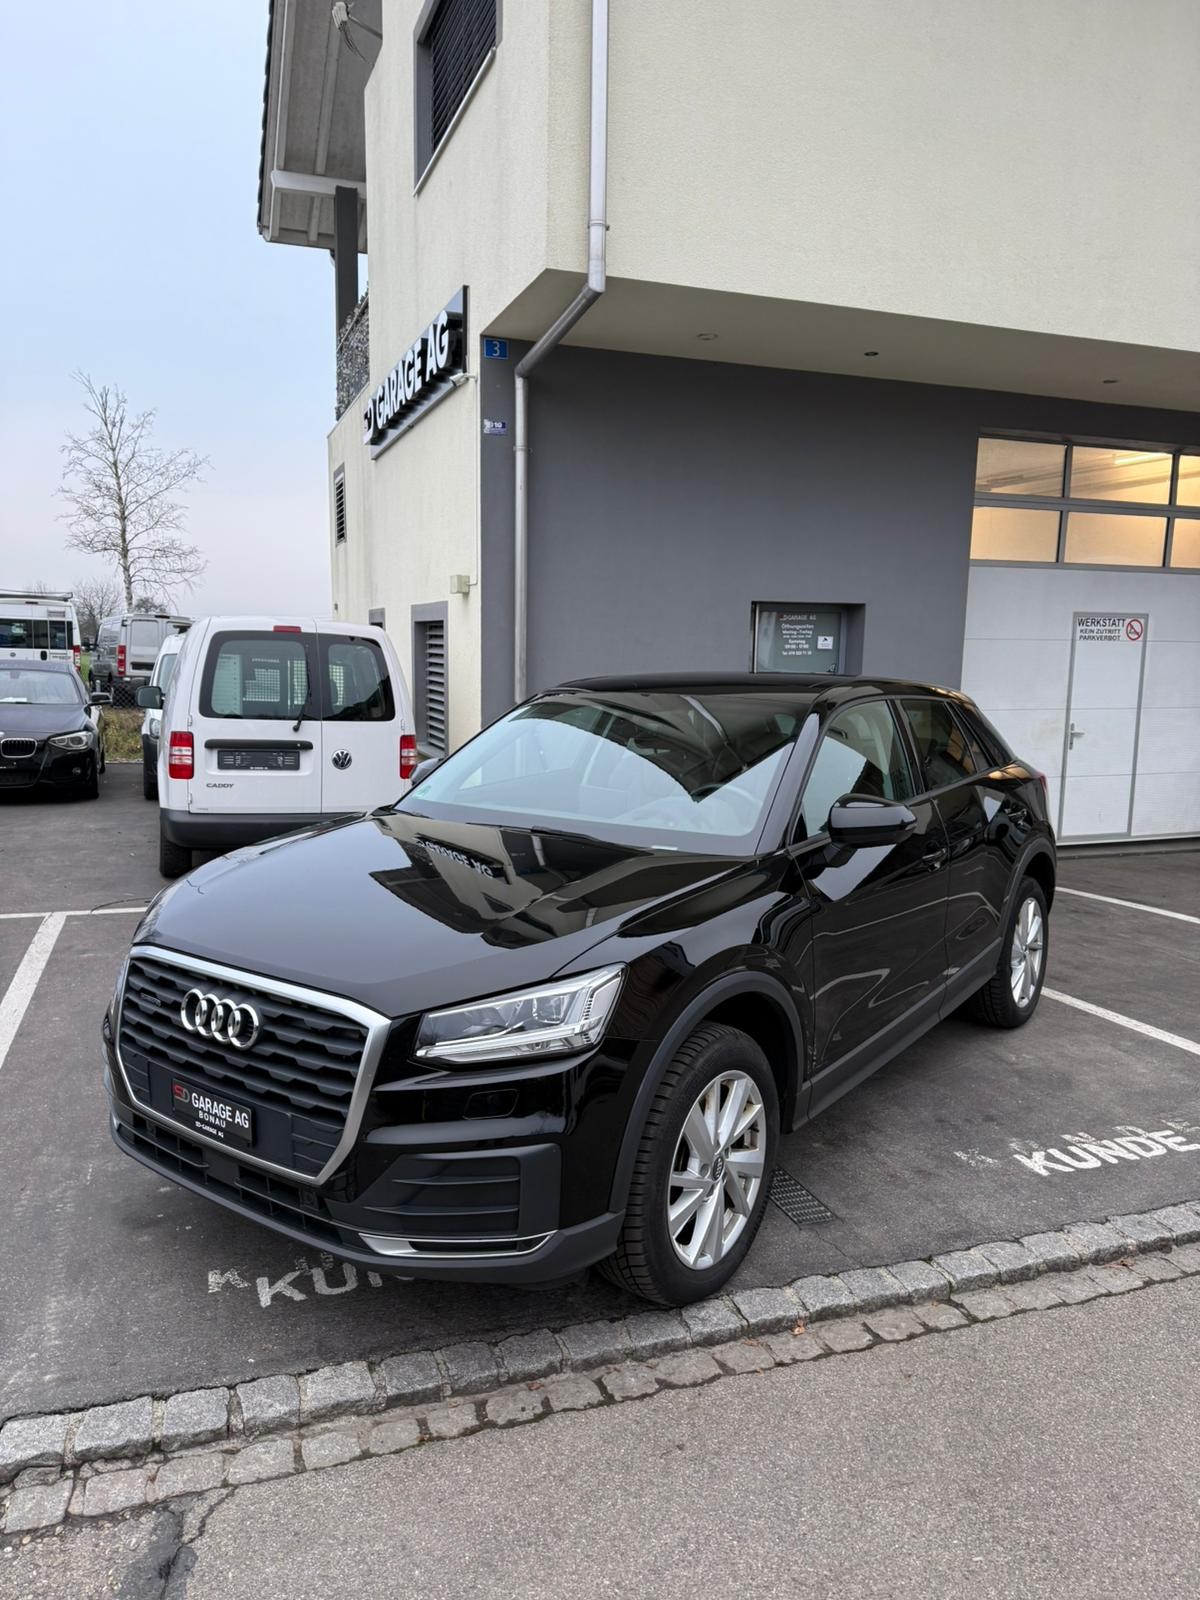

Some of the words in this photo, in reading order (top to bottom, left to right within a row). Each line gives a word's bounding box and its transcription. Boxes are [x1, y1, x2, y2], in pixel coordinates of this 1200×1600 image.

[492, 341, 500, 356] 3
[376, 337, 422, 429] GARAGE
[425, 310, 449, 382] AG
[1077, 618, 1126, 627] WERKSTATT
[191, 1092, 233, 1122] GARAGE
[234, 1110, 249, 1128] AG
[198, 1110, 226, 1128] BONAU
